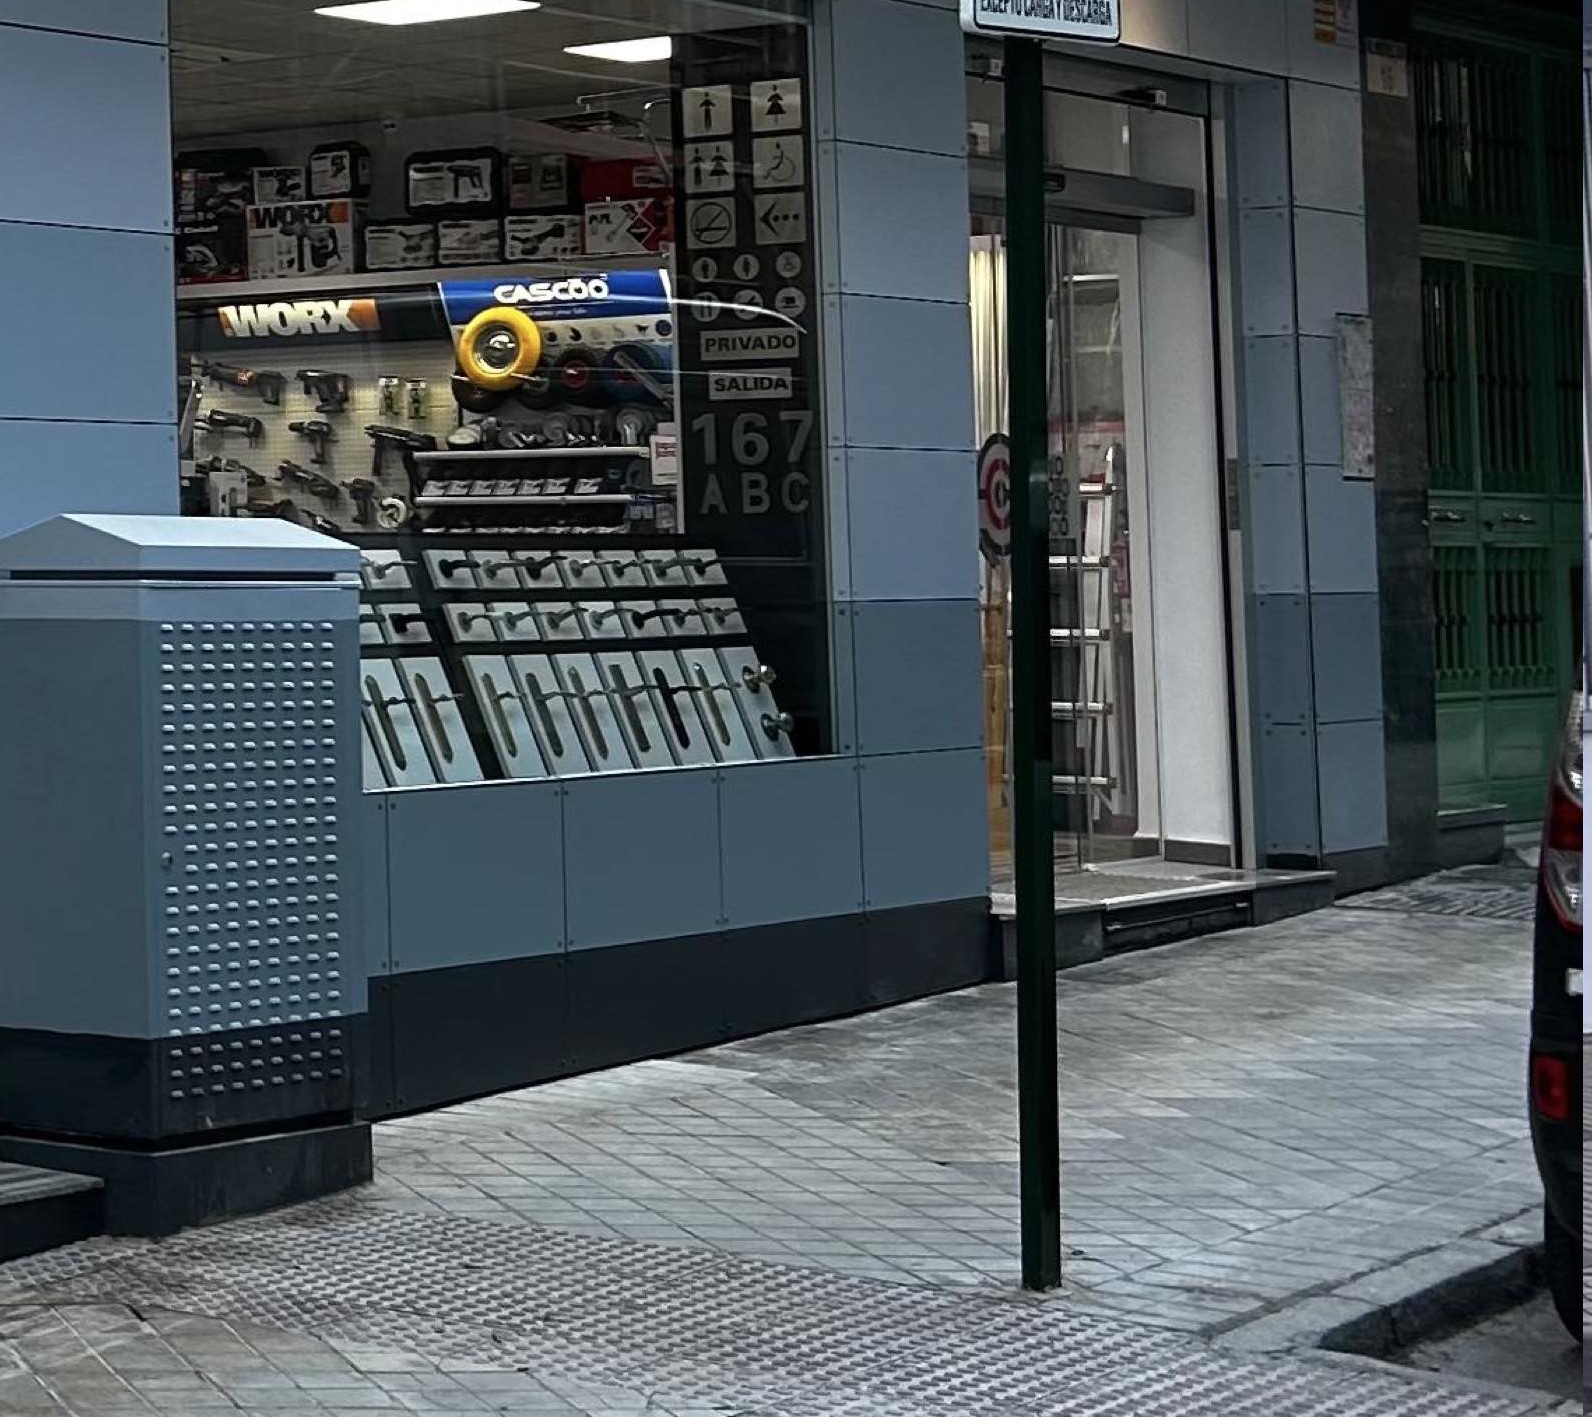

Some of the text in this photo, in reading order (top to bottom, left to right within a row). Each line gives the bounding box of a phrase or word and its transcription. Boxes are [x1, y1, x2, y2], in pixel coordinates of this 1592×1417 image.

[223, 298, 359, 337] WORX
[704, 334, 796, 353] PRIVADO
[714, 376, 790, 393] SALIDA
